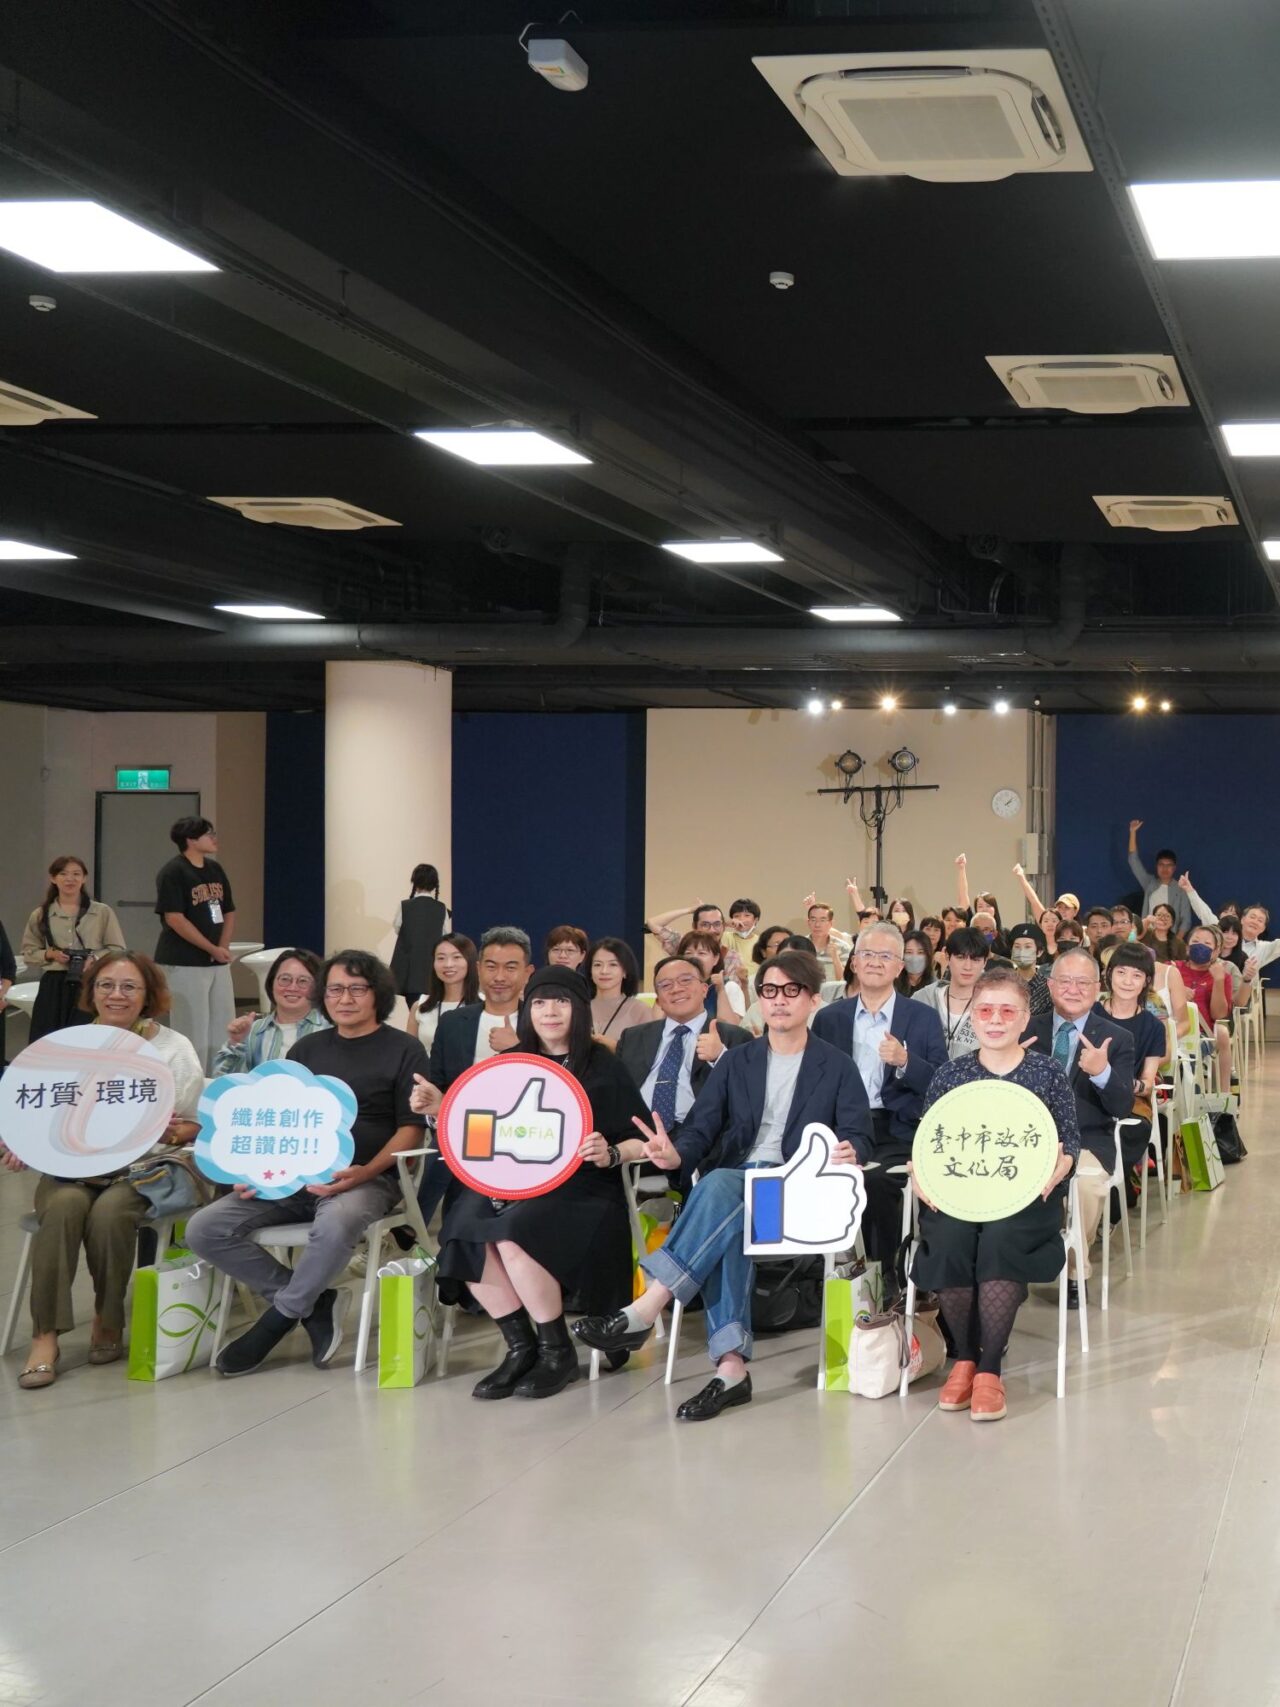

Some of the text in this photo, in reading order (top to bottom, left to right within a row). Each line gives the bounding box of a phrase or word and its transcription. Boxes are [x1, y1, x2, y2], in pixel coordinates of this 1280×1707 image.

[231, 1107, 324, 1128] 纖維創作
[930, 1123, 1042, 1154] 臺中市政府
[943, 1155, 1018, 1181] 文化局
